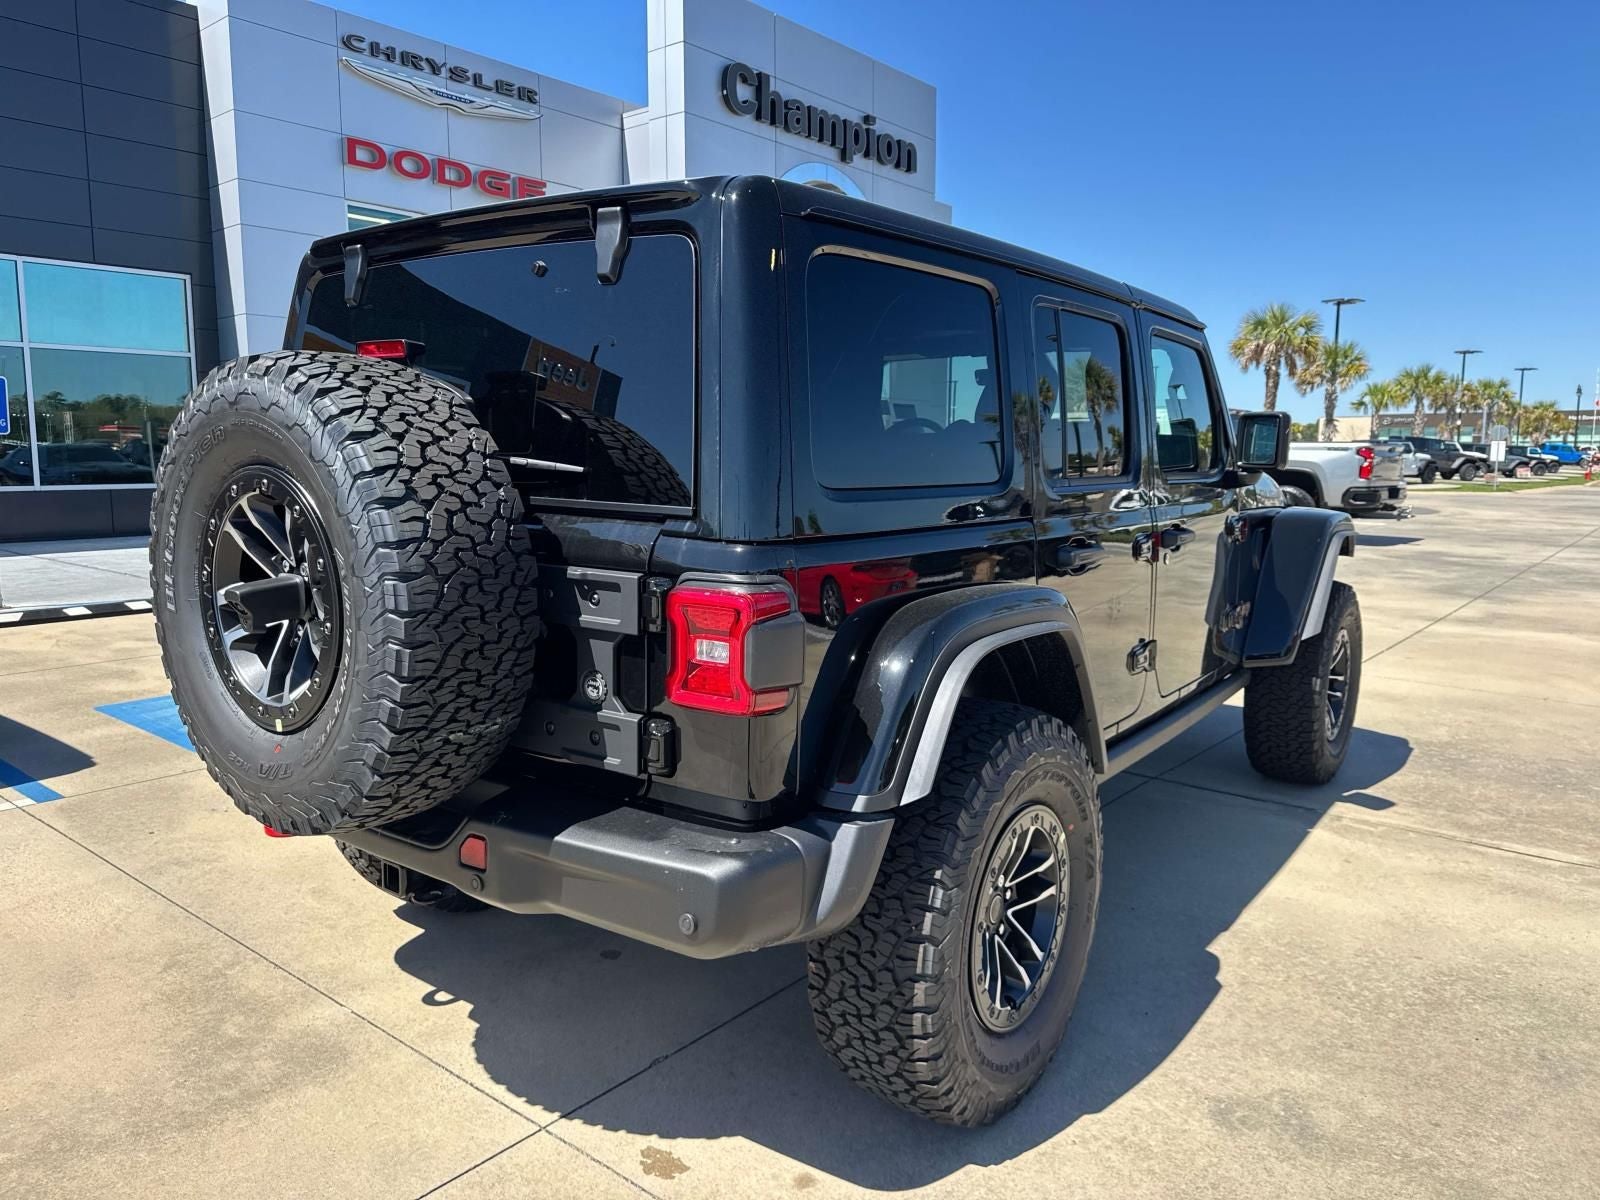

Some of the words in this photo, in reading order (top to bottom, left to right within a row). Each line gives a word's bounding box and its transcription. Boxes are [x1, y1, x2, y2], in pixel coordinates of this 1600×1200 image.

[341, 34, 540, 105] CHRYSLER
[721, 61, 918, 174] Champion
[342, 137, 547, 200] DODGE
